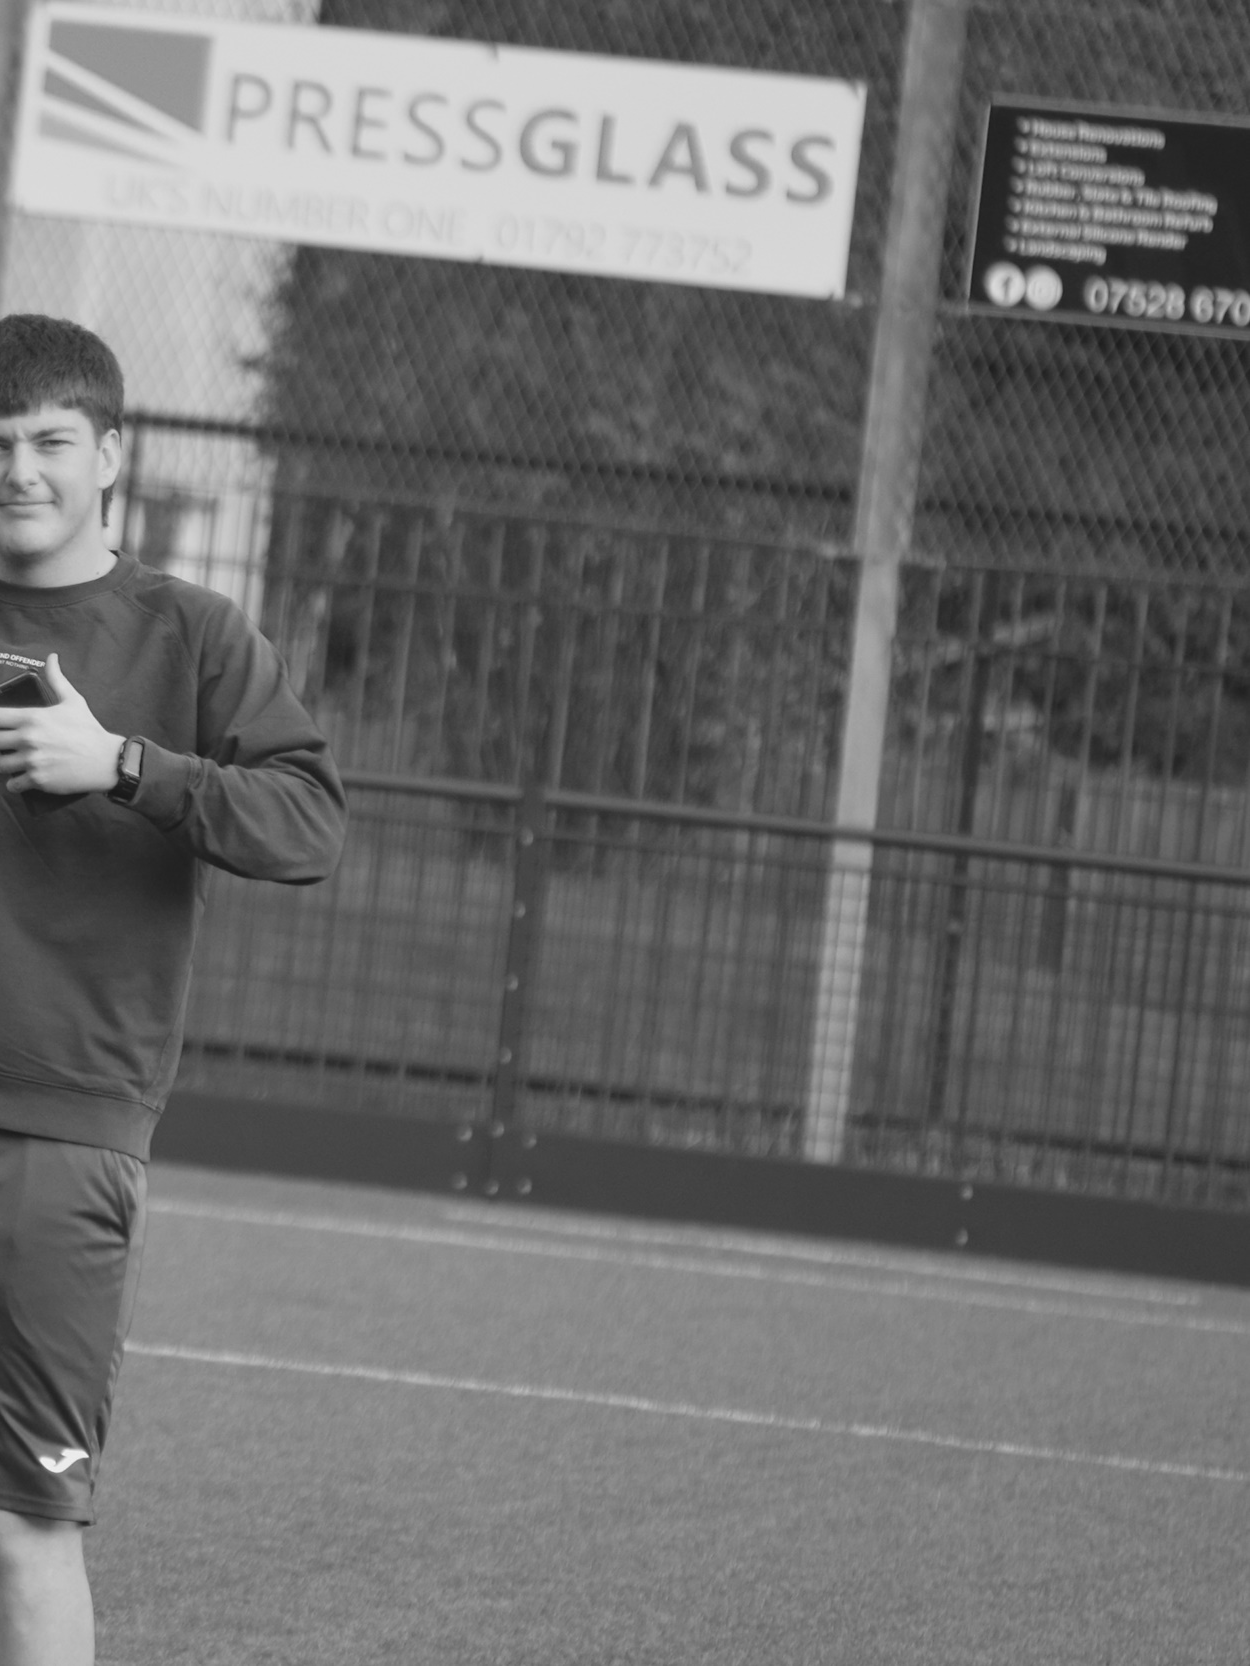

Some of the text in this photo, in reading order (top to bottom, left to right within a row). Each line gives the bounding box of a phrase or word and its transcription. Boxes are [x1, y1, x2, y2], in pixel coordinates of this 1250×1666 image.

[225, 72, 837, 207] PRESSGLASS
[200, 182, 369, 235] NUMBER
[380, 202, 465, 245] ONE
[494, 211, 608, 262] 01792
[620, 224, 753, 275] 773752
[10, 654, 46, 667] OFFENDER
